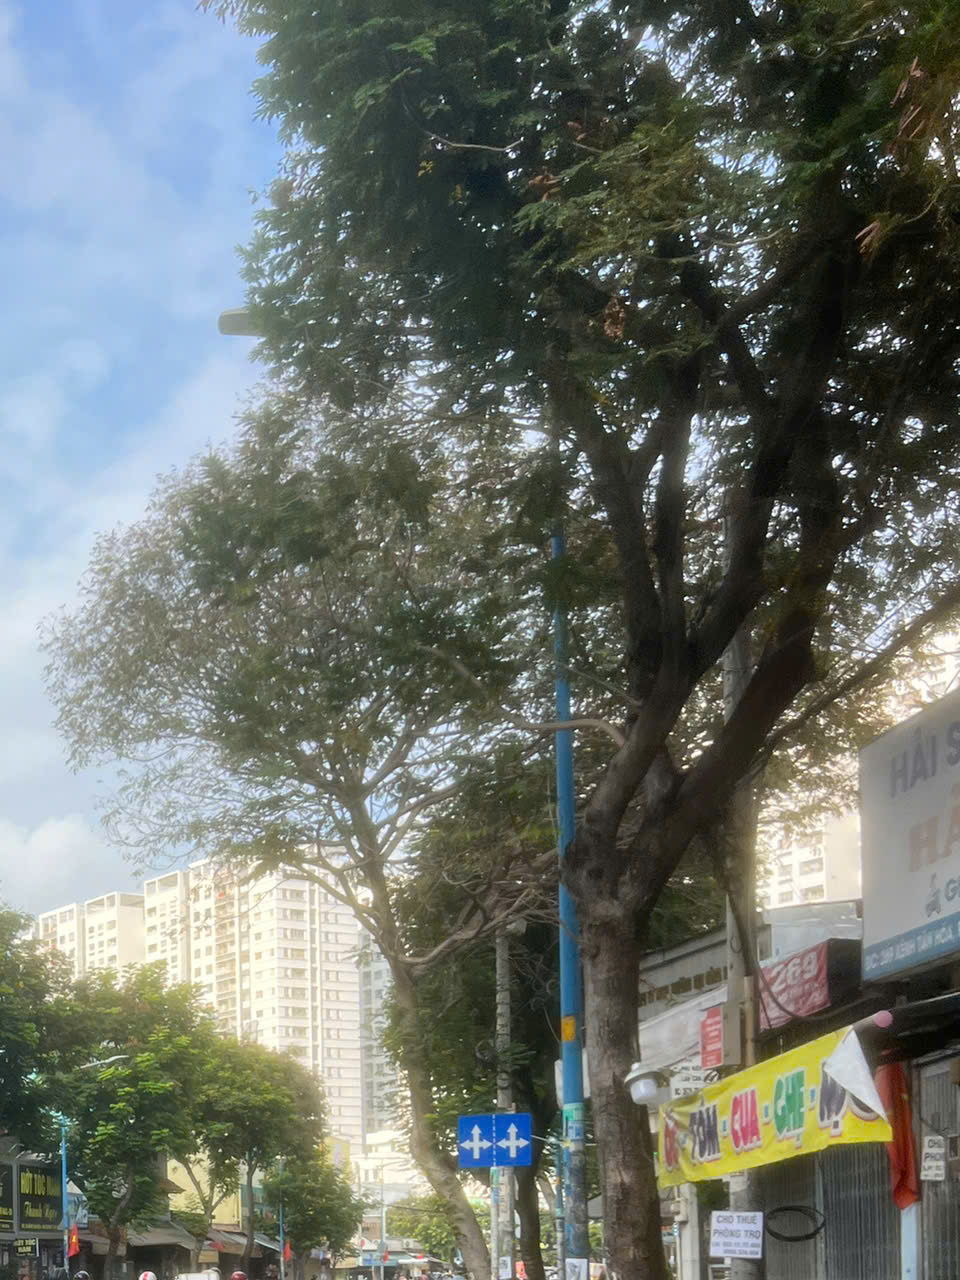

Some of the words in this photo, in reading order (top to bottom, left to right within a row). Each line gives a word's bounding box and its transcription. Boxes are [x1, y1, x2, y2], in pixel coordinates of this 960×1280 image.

[771, 951, 818, 992] 269
[690, 1096, 720, 1160] TÔM
[731, 1089, 760, 1150] CUA
[773, 1069, 806, 1146] GHẸ
[717, 1215, 734, 1224] CHO
[736, 1213, 757, 1224] THUÊ
[713, 1226, 741, 1238] PHÒNG
